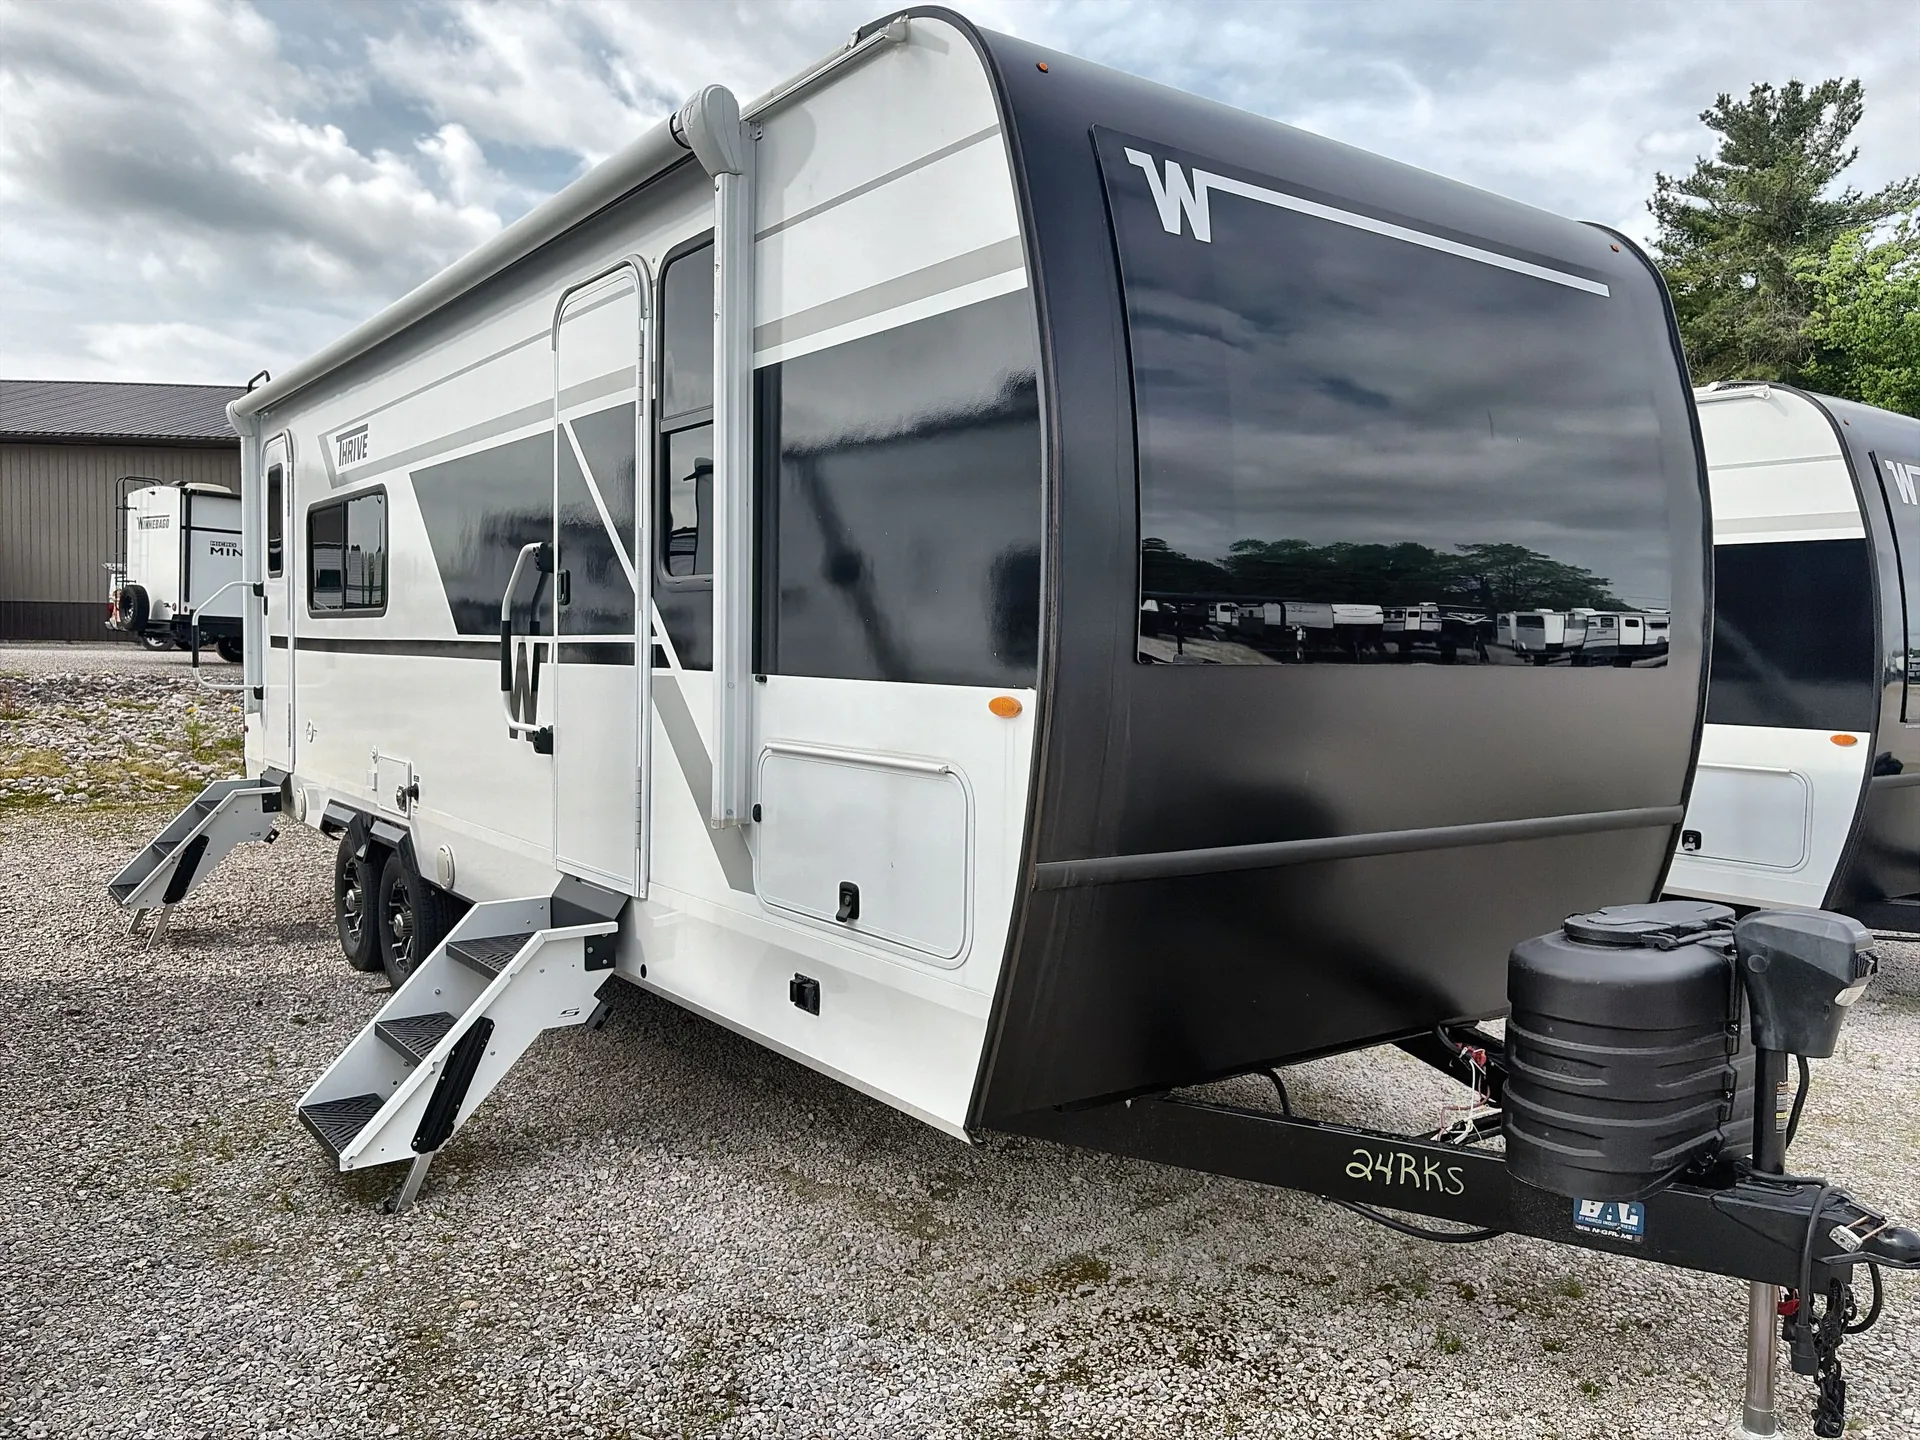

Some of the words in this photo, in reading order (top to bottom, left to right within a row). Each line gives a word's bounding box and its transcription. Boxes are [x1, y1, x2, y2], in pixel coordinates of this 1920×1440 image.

[1124, 147, 1211, 243] W
[336, 423, 368, 467] THRIVE
[1884, 460, 1918, 506] W
[136, 515, 170, 530] WINNEBAGO
[1345, 1149, 1464, 1195] 24RKS
[1579, 1199, 1639, 1226] BAL
